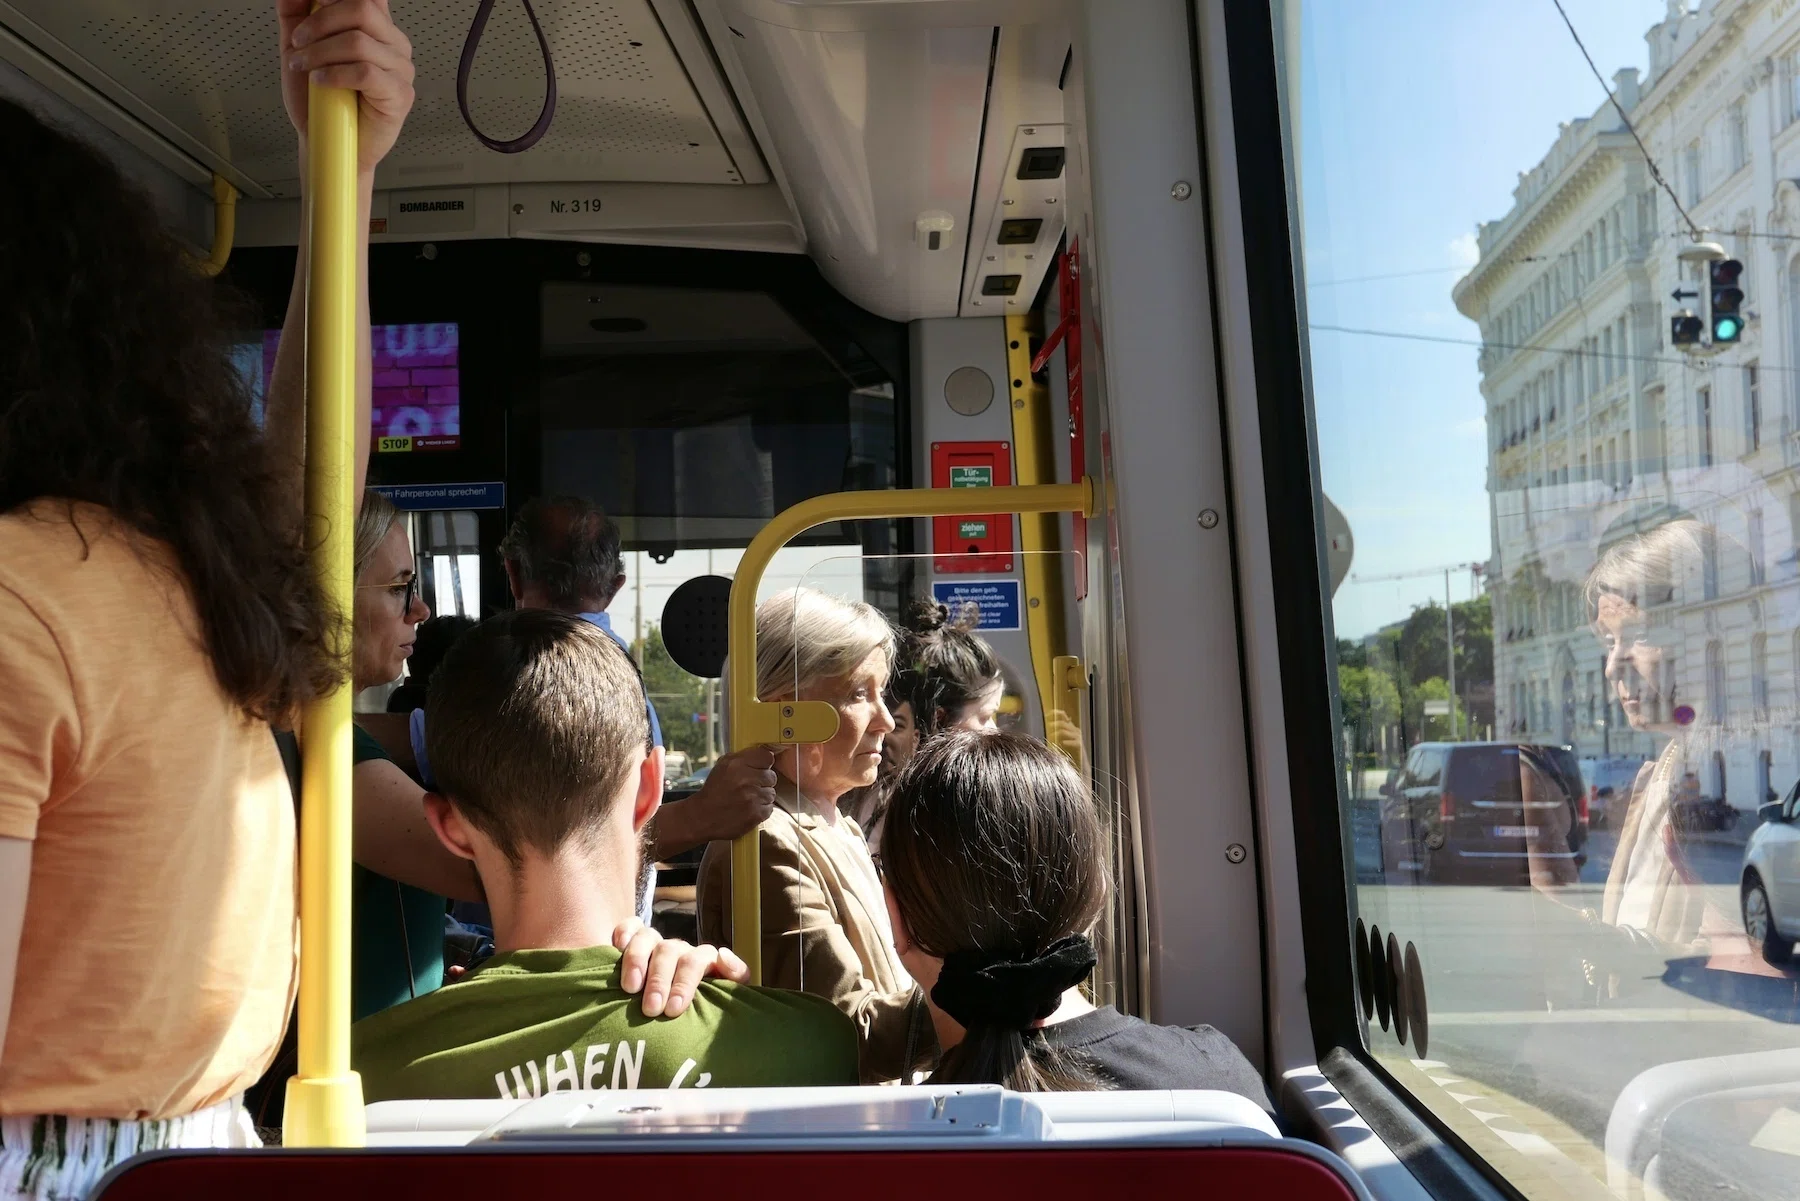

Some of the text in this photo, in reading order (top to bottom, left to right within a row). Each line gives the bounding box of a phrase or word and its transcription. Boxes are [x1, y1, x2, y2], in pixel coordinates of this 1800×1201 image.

[400, 201, 464, 213] BOMBARDIER
[550, 199, 602, 213] Nr. 319
[382, 439, 409, 450] STOP
[963, 468, 979, 477] Tür-
[395, 488, 447, 499] Fahrpersonal
[448, 486, 487, 498] sprechen!
[961, 523, 985, 532] ziehen
[494, 1039, 646, 1100] WHEN
